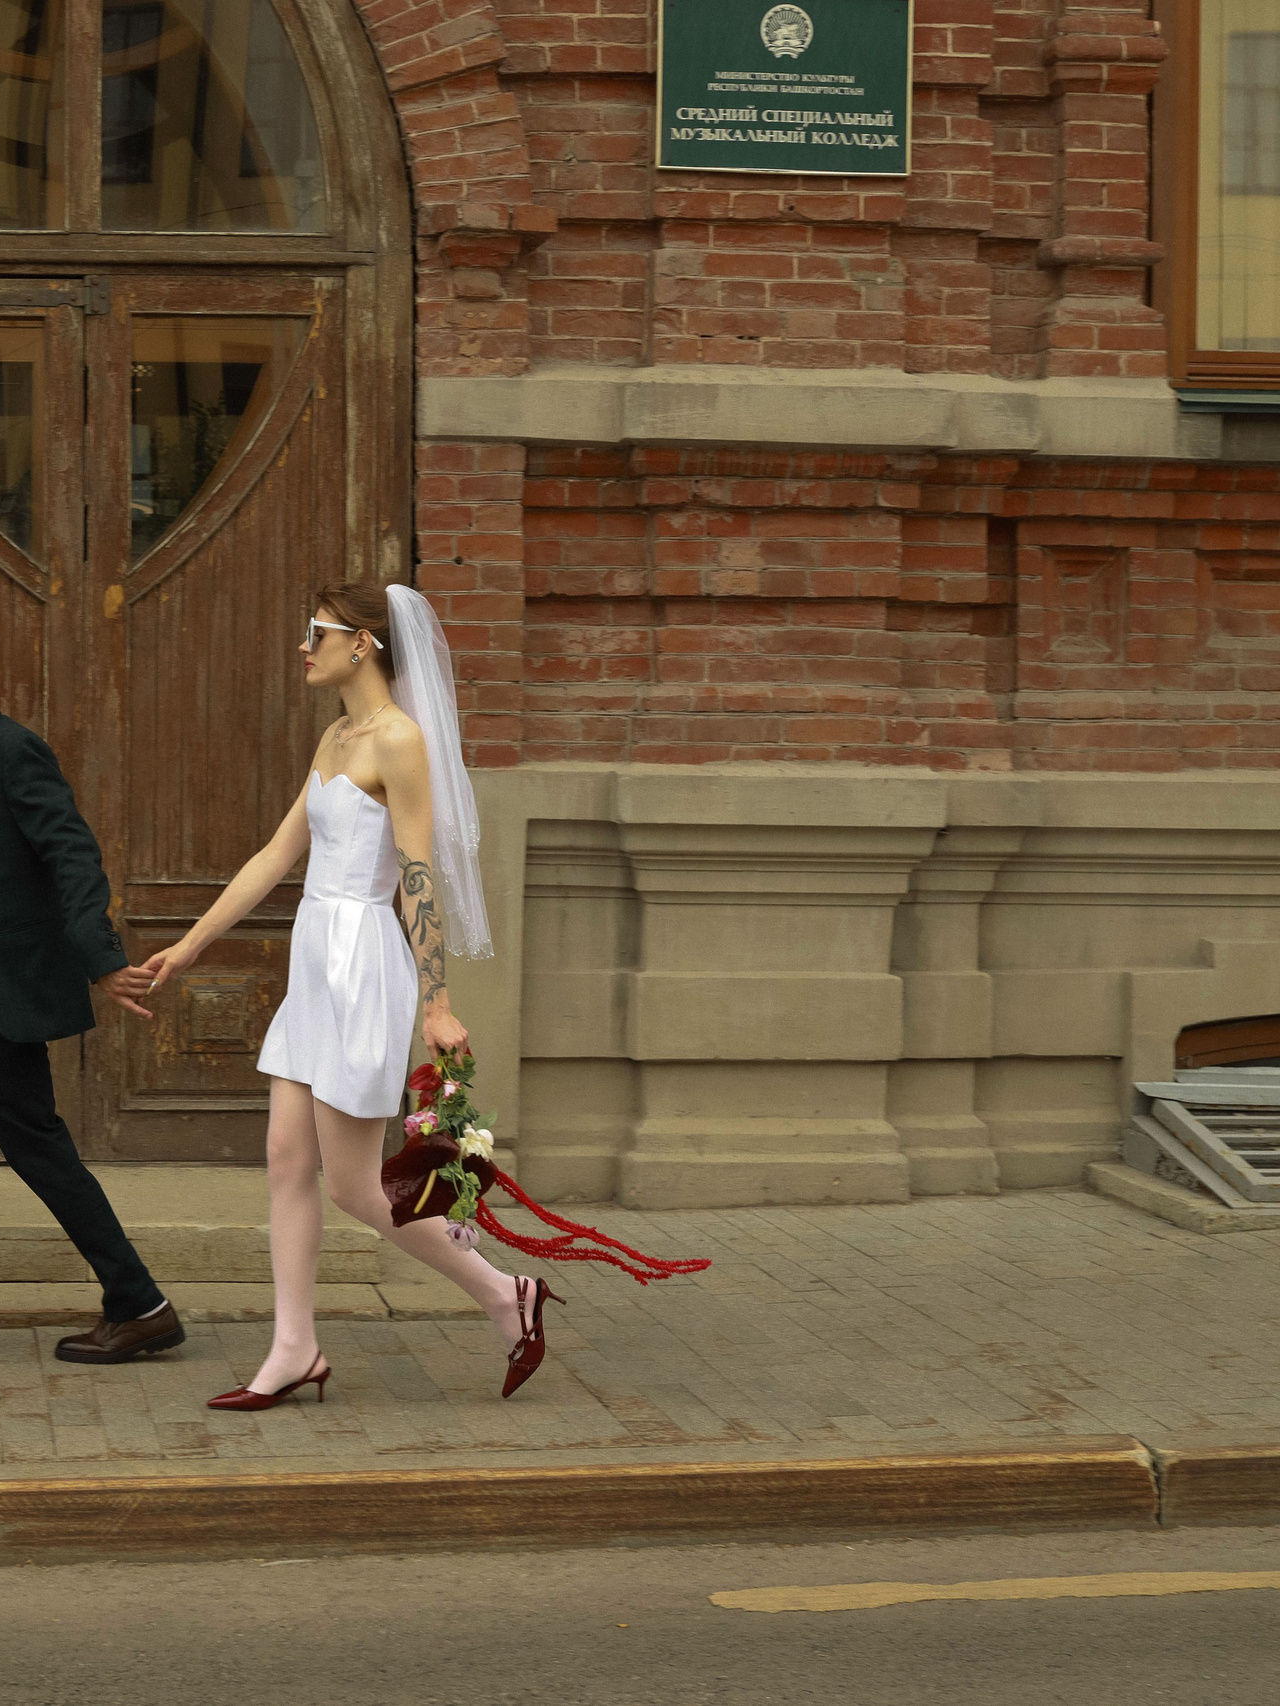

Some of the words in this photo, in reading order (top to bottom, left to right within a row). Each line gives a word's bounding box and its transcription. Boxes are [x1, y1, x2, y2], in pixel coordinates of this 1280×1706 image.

[780, 84, 865, 96] БАШКОРТОСТАН
[676, 105, 758, 124] СРЕДНИЙ
[761, 109, 894, 128] СПЕЦИАЛЬНЫЙ
[669, 126, 807, 144] МУЗЫКАЛЬНЫЙ
[810, 131, 899, 150] КОЛЛЕДЖ
